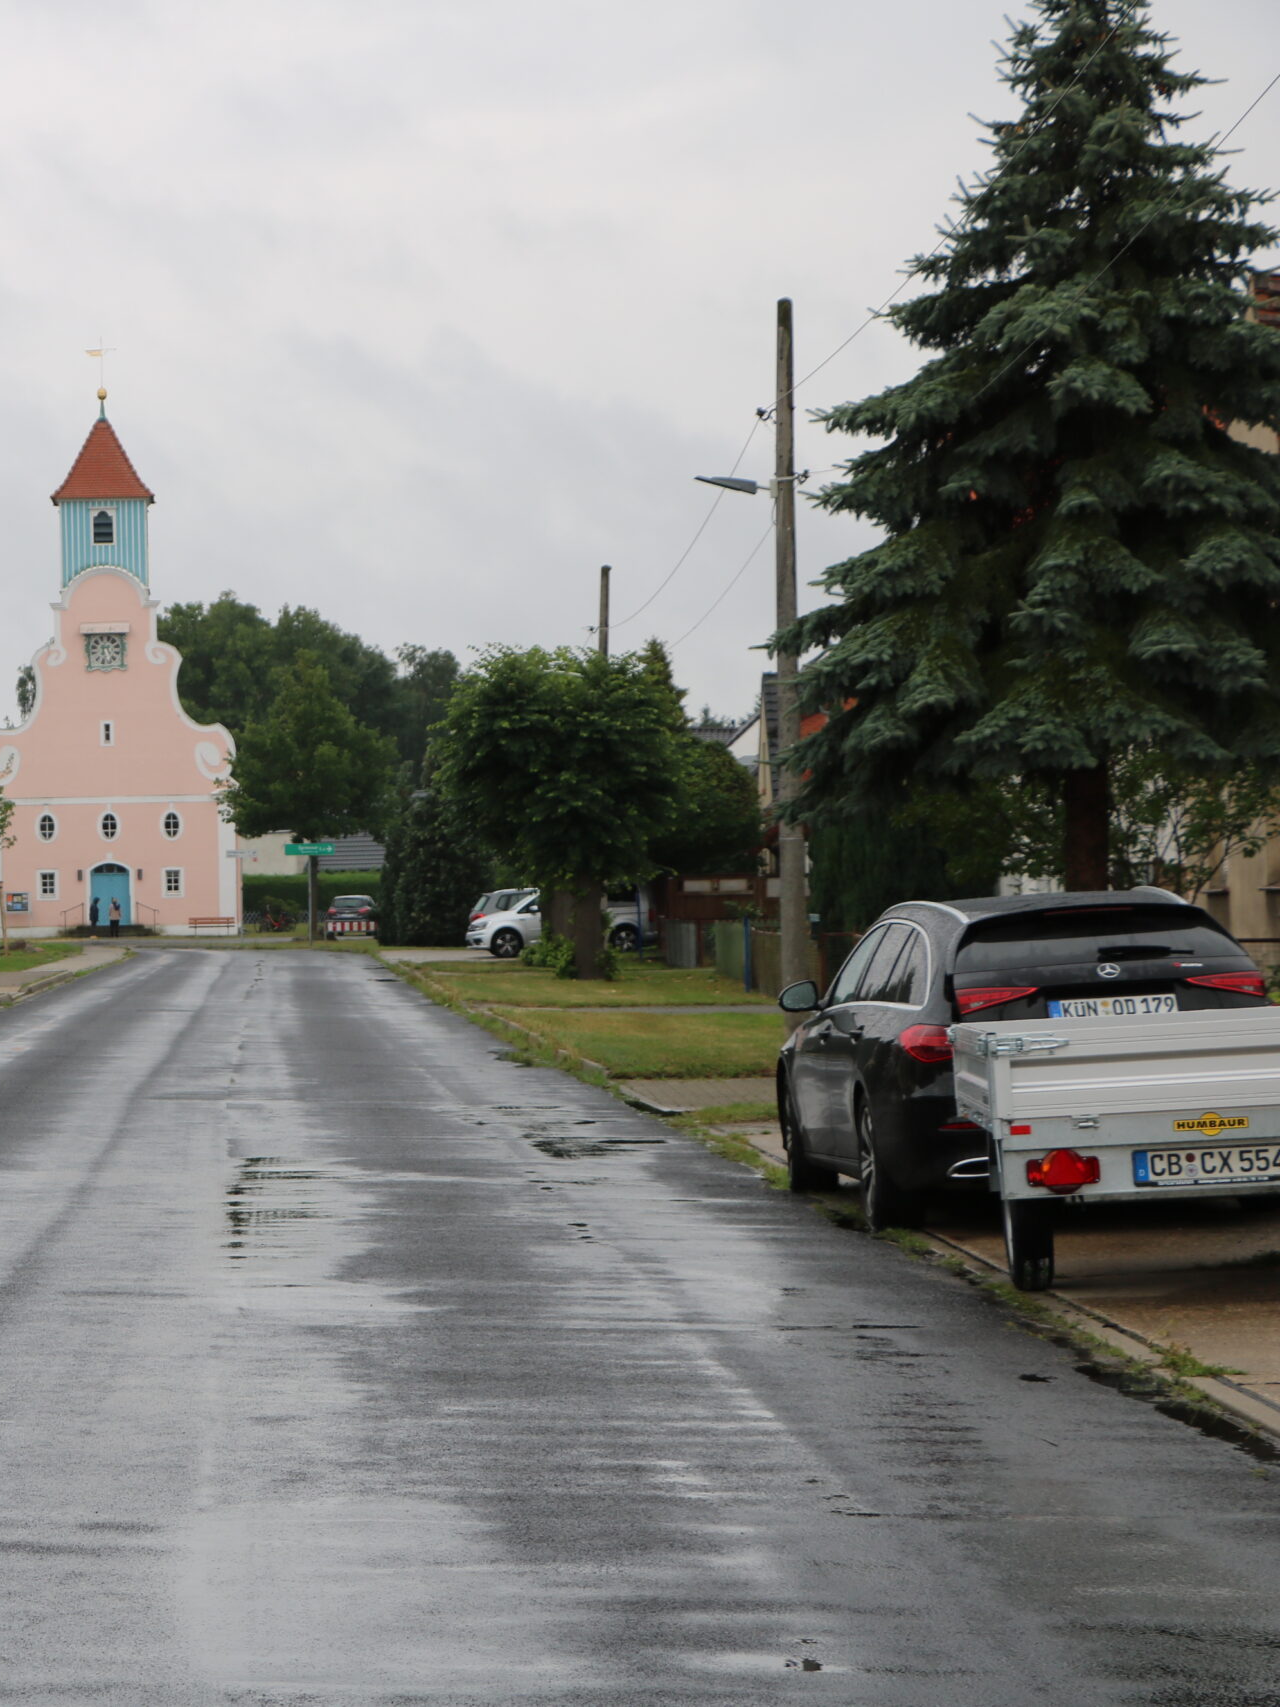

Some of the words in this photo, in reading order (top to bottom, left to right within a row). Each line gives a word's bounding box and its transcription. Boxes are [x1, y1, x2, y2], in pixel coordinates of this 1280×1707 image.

[1061, 1000, 1099, 1017] KÜN
[1111, 998, 1137, 1015] OD
[1140, 996, 1175, 1014] 179
[1176, 1118, 1246, 1129] HUMBAUR
[1150, 1153, 1183, 1177] CB
[1200, 1150, 1234, 1174] CX
